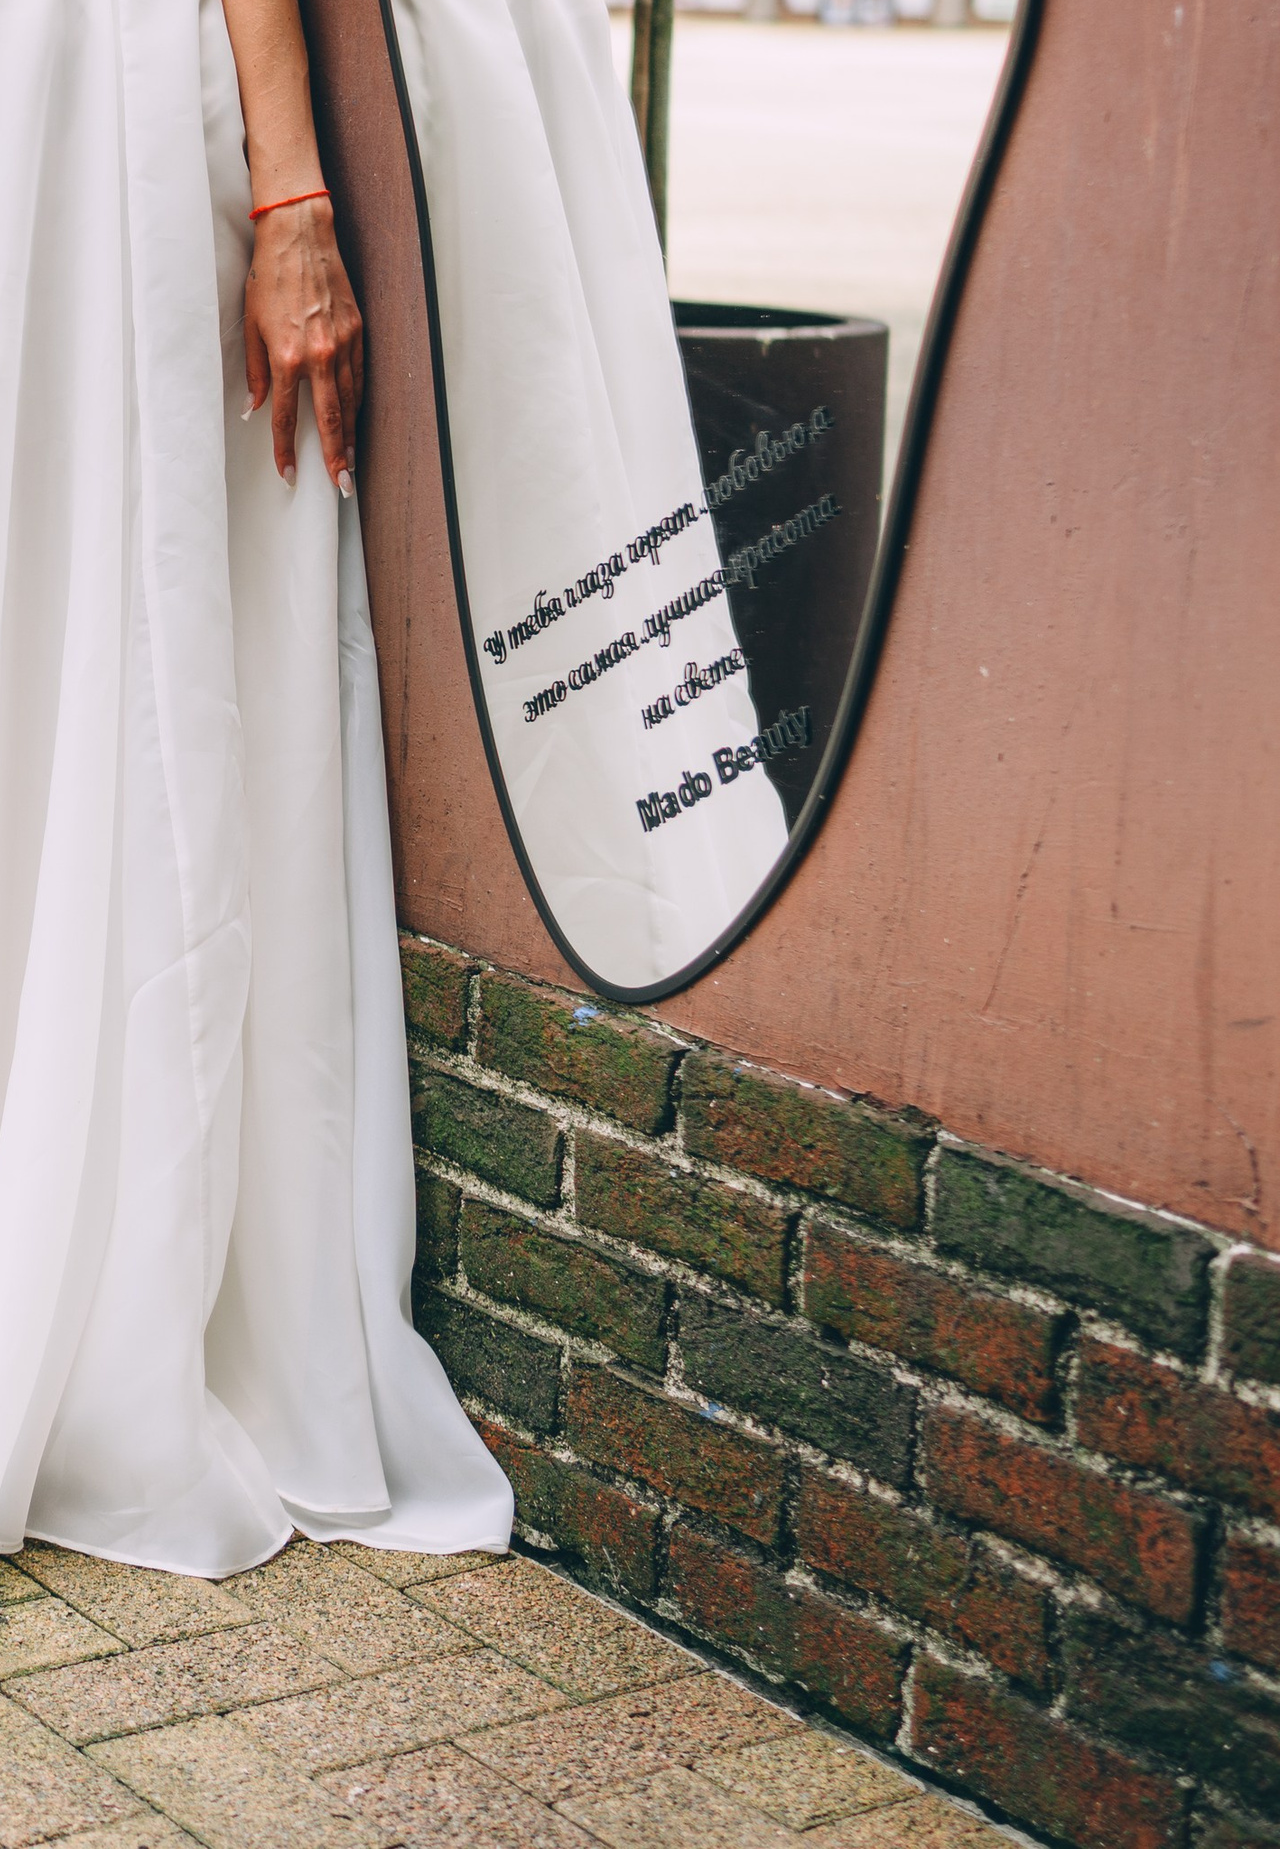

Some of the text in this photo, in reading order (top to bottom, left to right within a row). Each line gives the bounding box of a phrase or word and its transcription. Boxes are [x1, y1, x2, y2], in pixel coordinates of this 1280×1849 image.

[507, 590, 566, 649] тебя
[563, 552, 628, 599] глаза
[625, 503, 699, 565] горят
[522, 680, 569, 722] это
[568, 631, 640, 691] самая
[640, 568, 732, 647] лучшая
[641, 648, 754, 730] на свете
[635, 705, 812, 832] Mado Beauty
